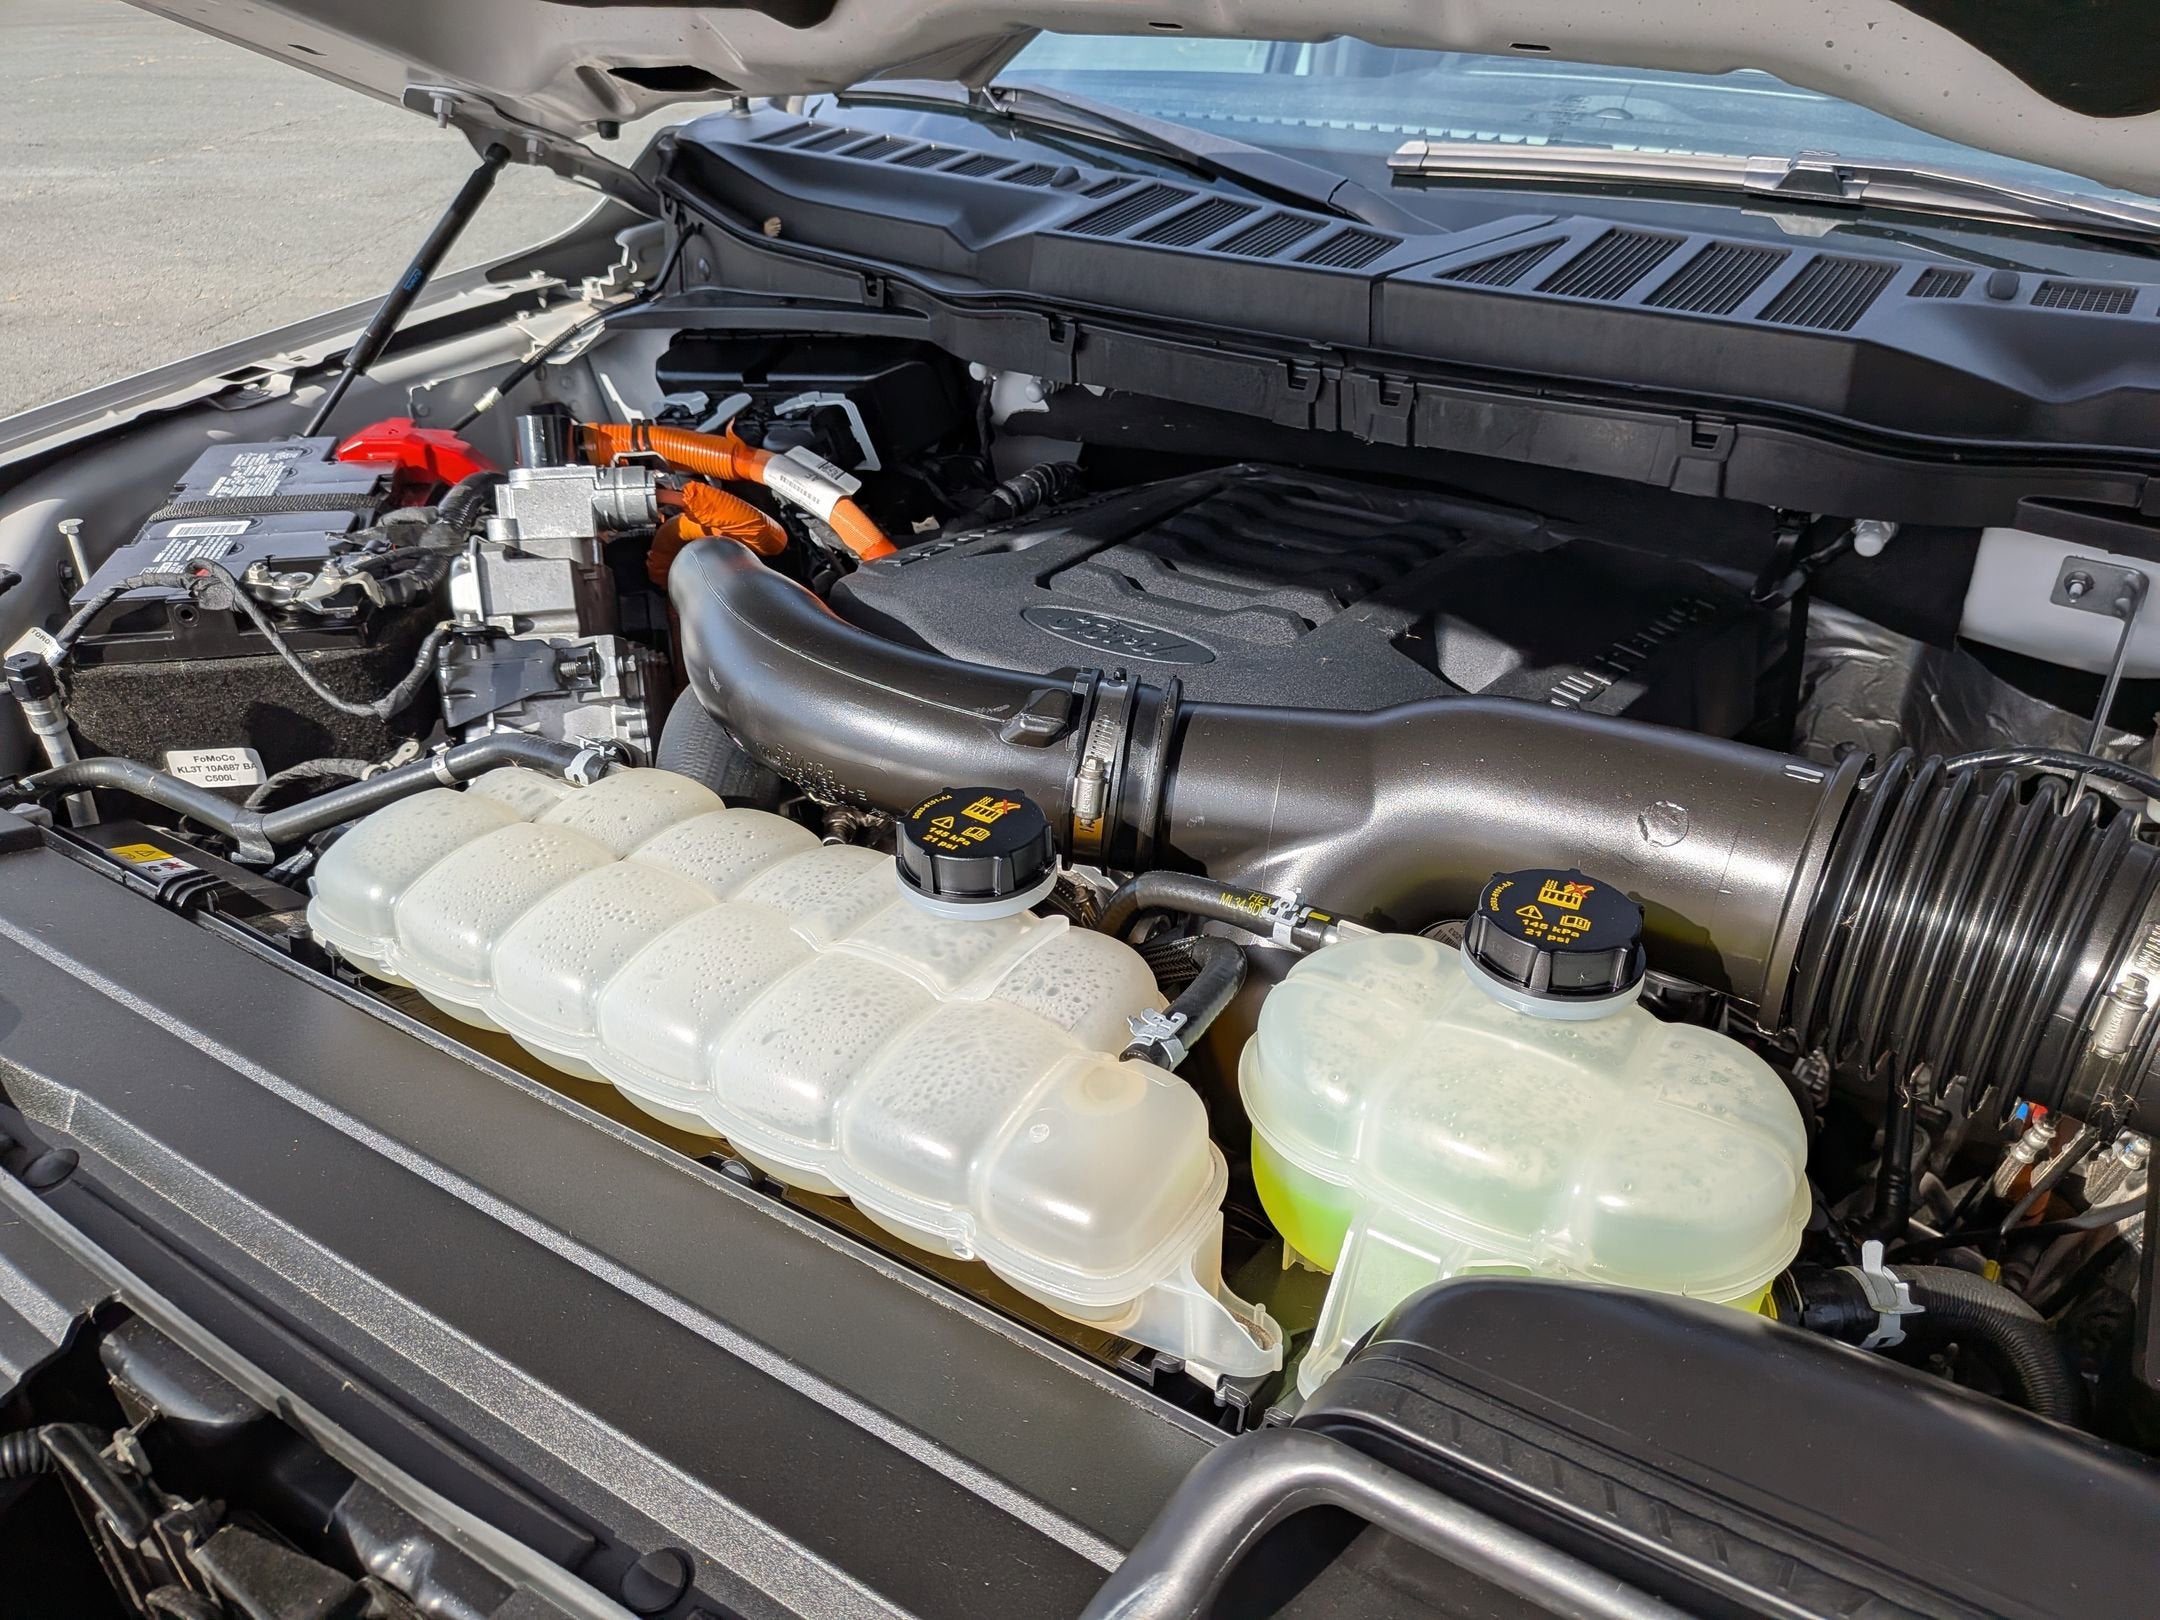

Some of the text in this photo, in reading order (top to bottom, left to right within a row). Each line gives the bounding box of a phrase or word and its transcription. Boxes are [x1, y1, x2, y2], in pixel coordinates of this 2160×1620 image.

[193, 754, 235, 763] FoMoCo
[177, 762, 258, 774] KL3T 10A687 BA
[205, 774, 236, 782] C500L
[922, 835, 958, 850] 21 psi
[929, 827, 971, 846] 145 kPa
[1219, 892, 1262, 918] ML34-8D
[1522, 919, 1580, 938] 145 kPa
[1524, 928, 1570, 944] 21 psi
